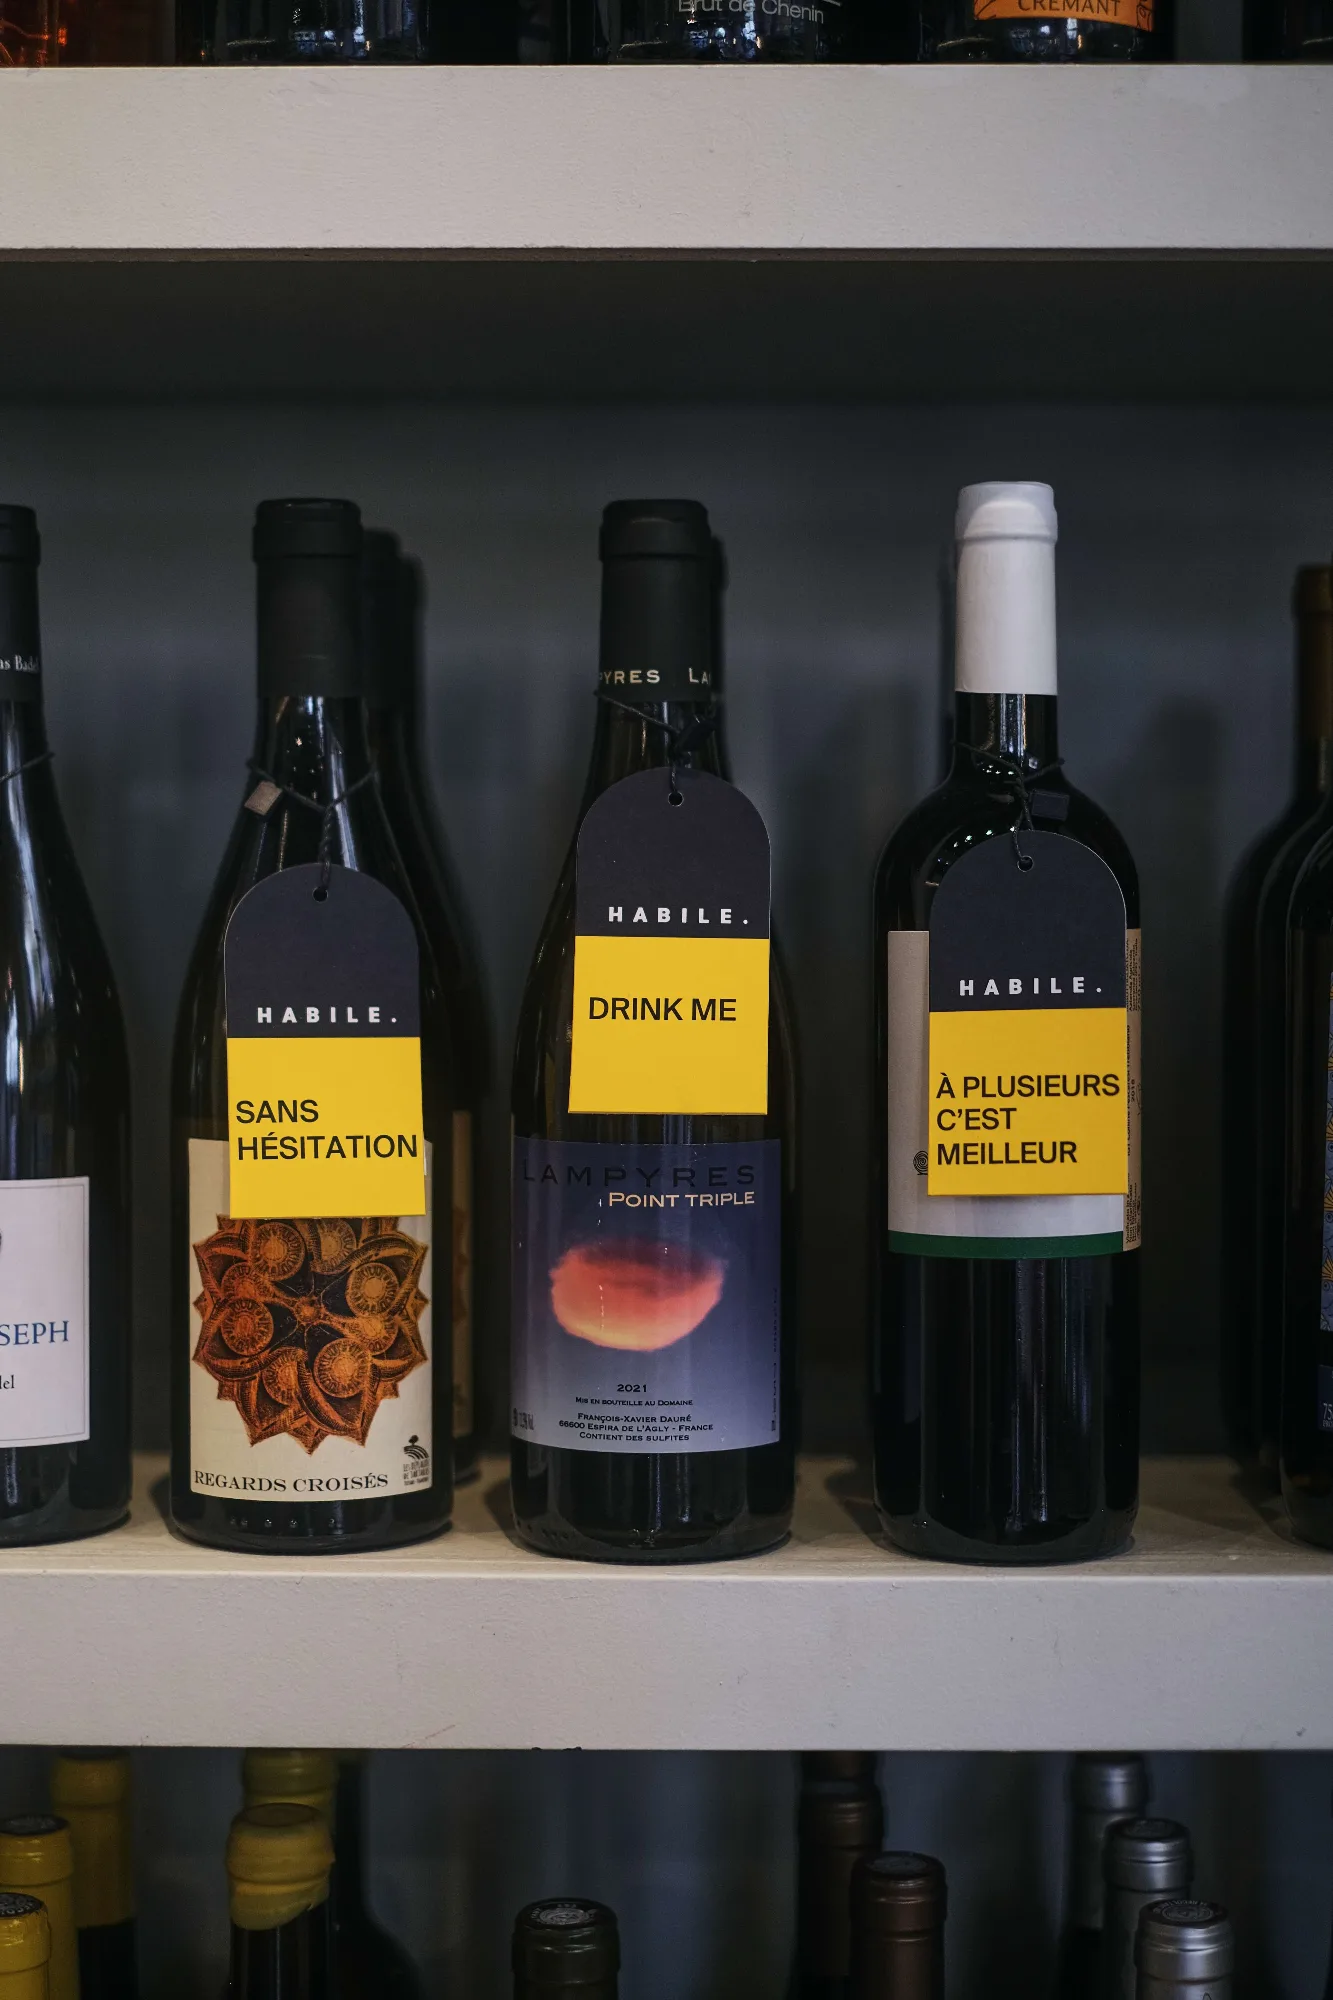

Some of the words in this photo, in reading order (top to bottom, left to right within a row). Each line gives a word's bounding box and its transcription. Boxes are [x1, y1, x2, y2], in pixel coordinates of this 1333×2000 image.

[678, 0, 723, 12] Brut
[729, 0, 756, 12] de
[762, 0, 824, 24] Chenin
[688, 667, 711, 685] LA
[608, 906, 749, 925] HABILE.
[959, 976, 1102, 997] HABILE.
[257, 1006, 398, 1024] HABILE.
[588, 996, 684, 1022] DRINK
[691, 998, 737, 1022] ME
[936, 1072, 956, 1099] À
[963, 1073, 1121, 1099] PLUSIEURS
[236, 1099, 320, 1124] SANS
[936, 1107, 1018, 1131] C’EST
[237, 1132, 418, 1161] HÉSITATION
[937, 1141, 1078, 1166] MEILLEUR
[523, 1158, 756, 1188] LAMPYRES
[608, 1192, 680, 1207] POINT
[685, 1191, 755, 1207] TRIPLE
[0, 1320, 70, 1346] SEPH
[617, 1384, 648, 1393] 2021
[559, 1420, 586, 1429] 66600
[678, 1423, 714, 1431] FRANCE
[194, 1470, 288, 1492] REGARDS
[293, 1472, 389, 1493] CROISÉS
